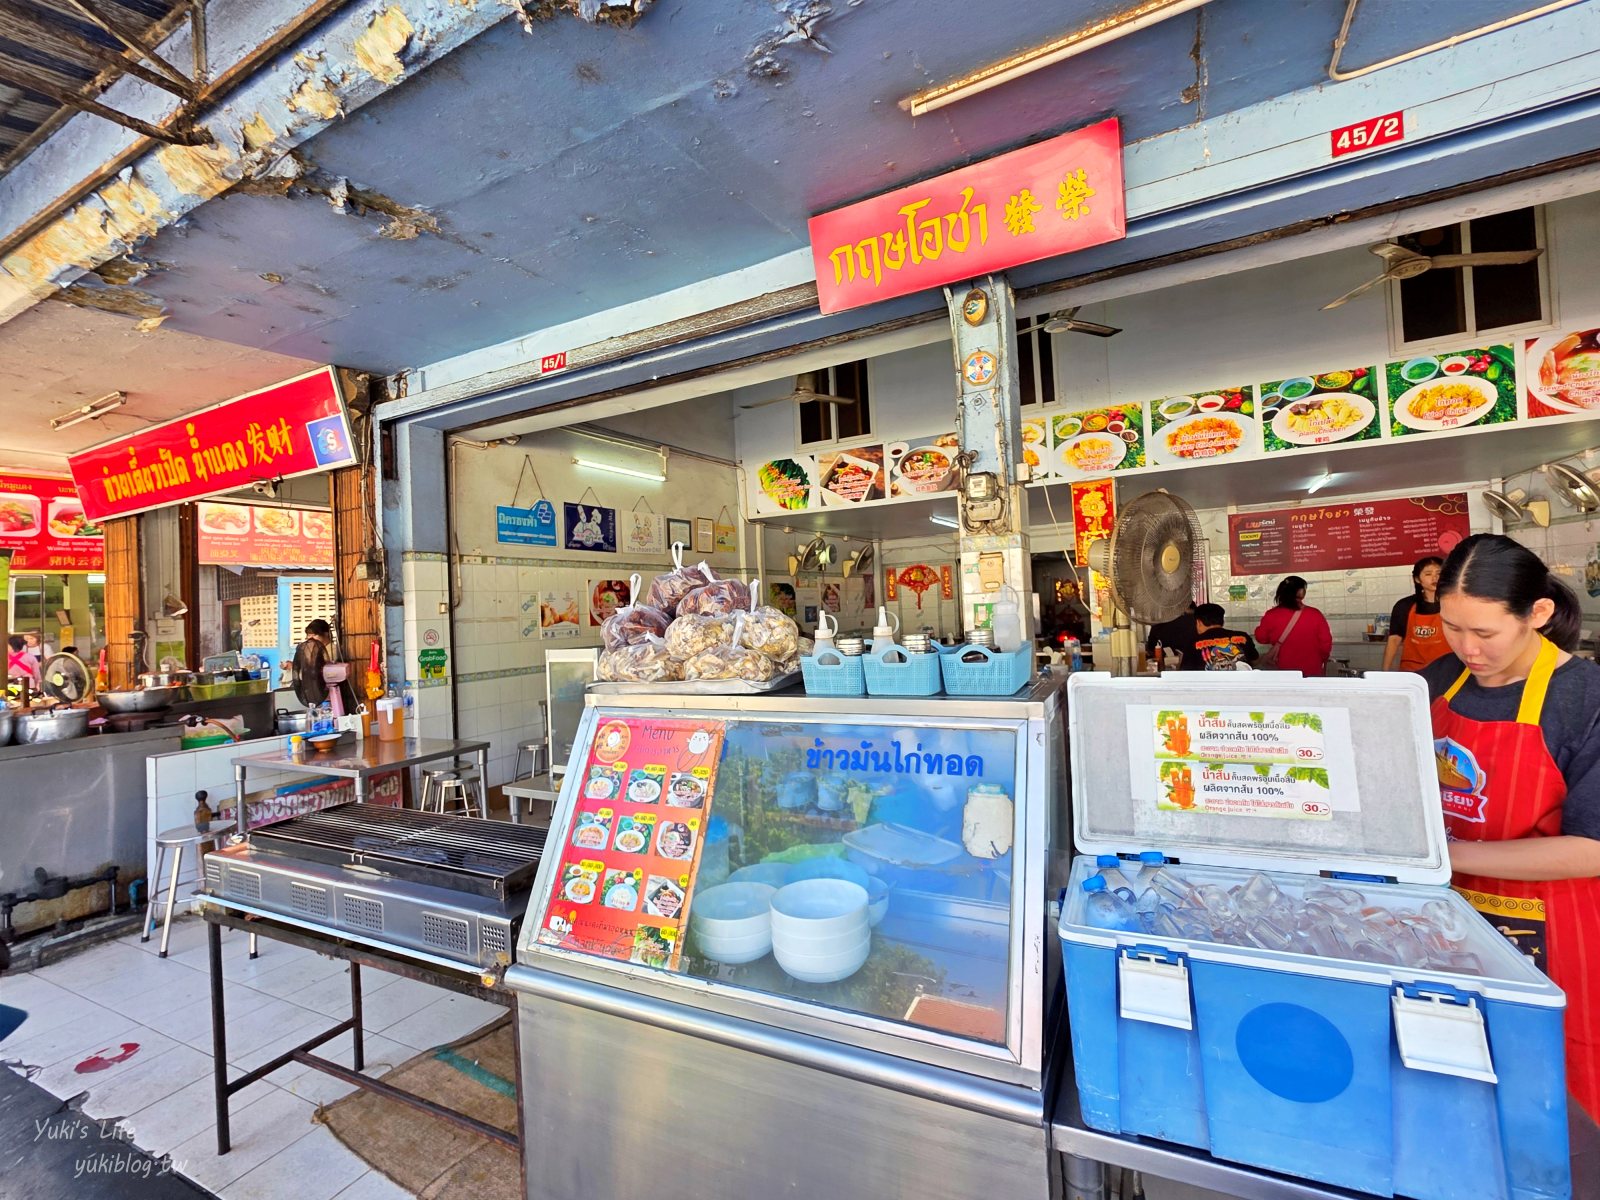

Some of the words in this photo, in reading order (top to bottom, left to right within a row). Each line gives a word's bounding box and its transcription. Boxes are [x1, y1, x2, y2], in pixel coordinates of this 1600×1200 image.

[1336, 117, 1399, 149] 45/2
[828, 186, 989, 287] กฤษโอชา
[543, 354, 564, 369] 45/1
[187, 422, 249, 482] น้ำแดง
[246, 416, 293, 466] 发财
[1291, 508, 1350, 522] กฤษโอชา
[1198, 713, 1227, 729] น้ำส้ม
[642, 725, 675, 741] Menu
[1199, 730, 1249, 742] ผลิตจากส้ม
[1251, 733, 1280, 742] 100%
[805, 737, 985, 778] ข้าวมันไก่ทอด
[1202, 766, 1231, 781] น้ำส้ม
[1203, 783, 1253, 795] ผลิตจากส้ม
[1256, 786, 1285, 796] 100%
